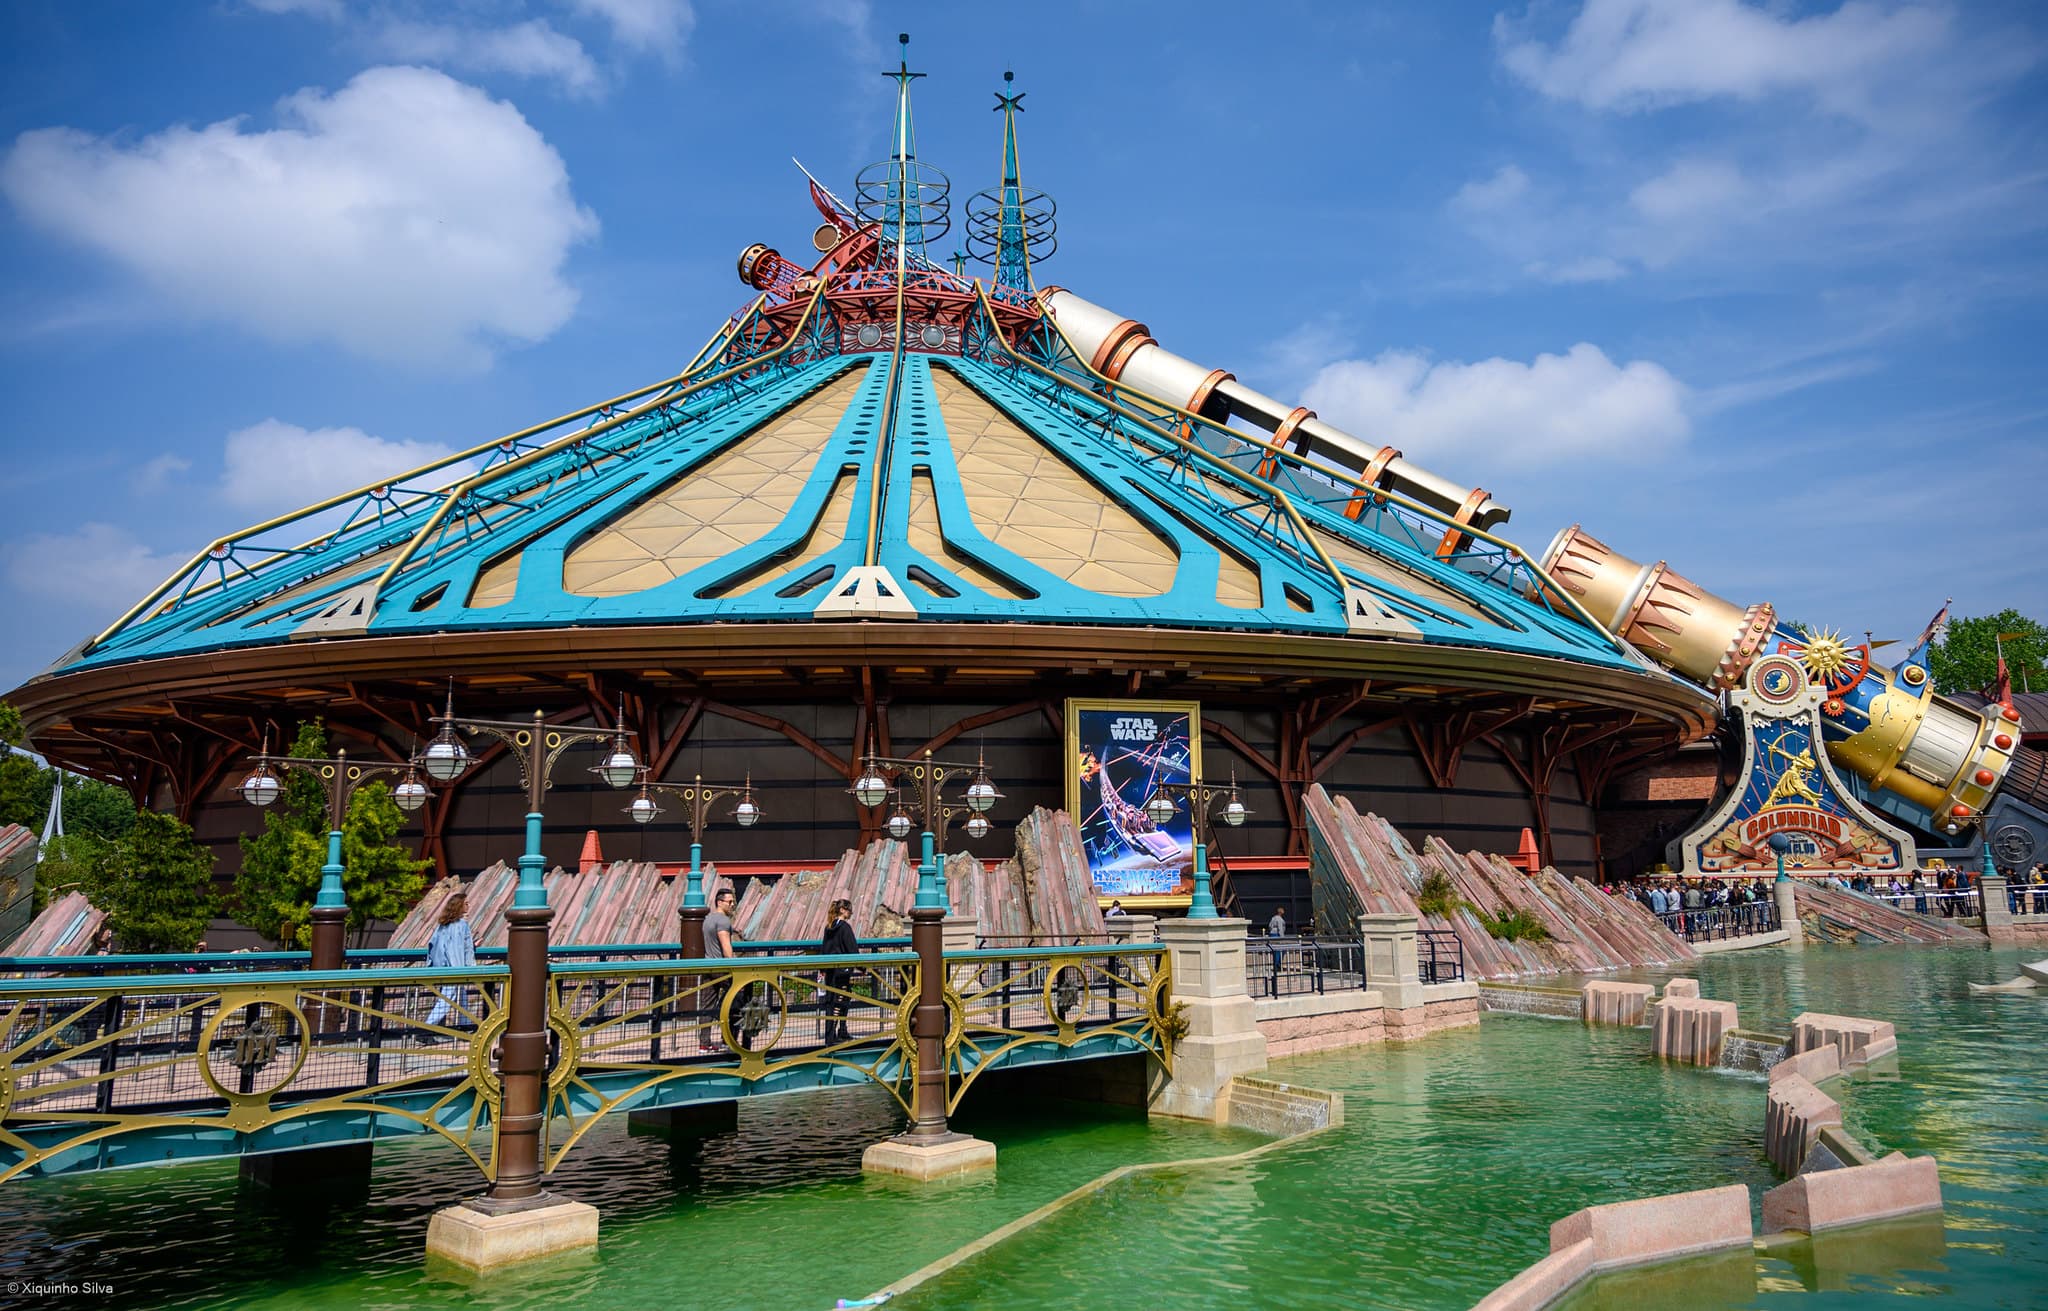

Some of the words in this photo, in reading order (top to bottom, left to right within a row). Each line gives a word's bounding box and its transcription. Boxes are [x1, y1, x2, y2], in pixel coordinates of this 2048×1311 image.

[1110, 718, 1158, 729] STAR
[1110, 729, 1158, 740] WARS
[1747, 811, 1841, 840] COLUMBIAD
[1793, 843, 1815, 854] CLUB
